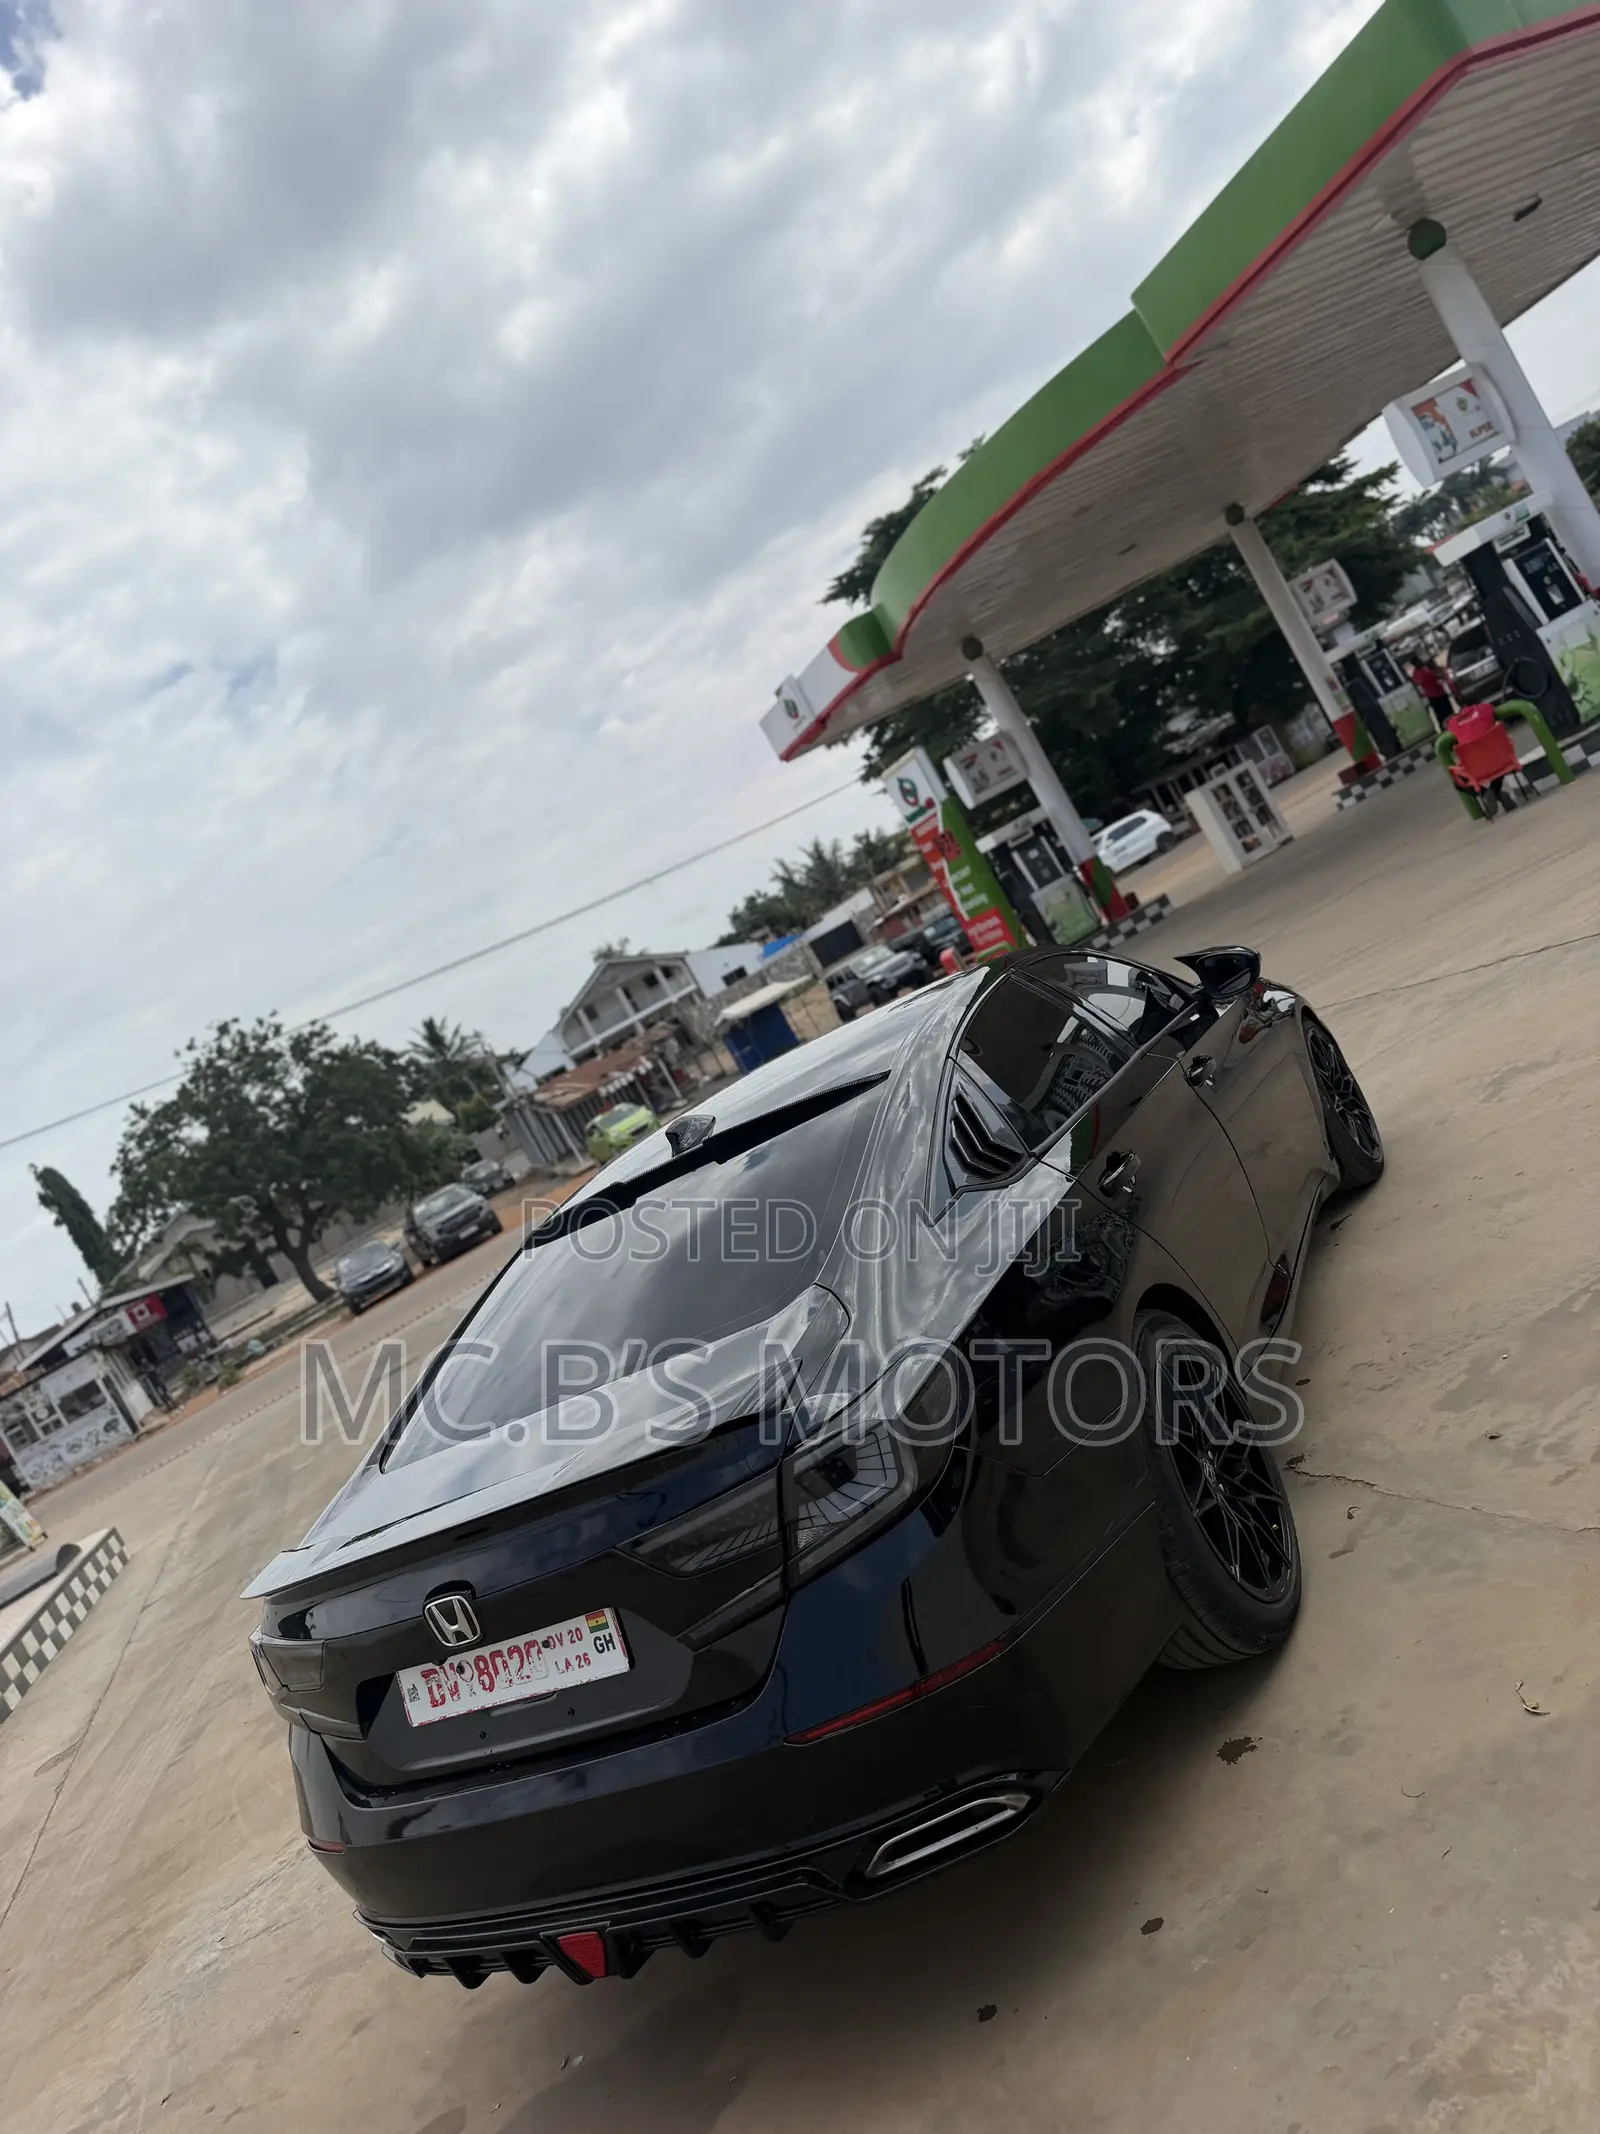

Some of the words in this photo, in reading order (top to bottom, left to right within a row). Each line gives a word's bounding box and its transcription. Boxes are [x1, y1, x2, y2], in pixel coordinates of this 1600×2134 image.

[567, 1627, 583, 1644] 20
[593, 1632, 616, 1654] GH
[575, 1652, 591, 1669] 26
